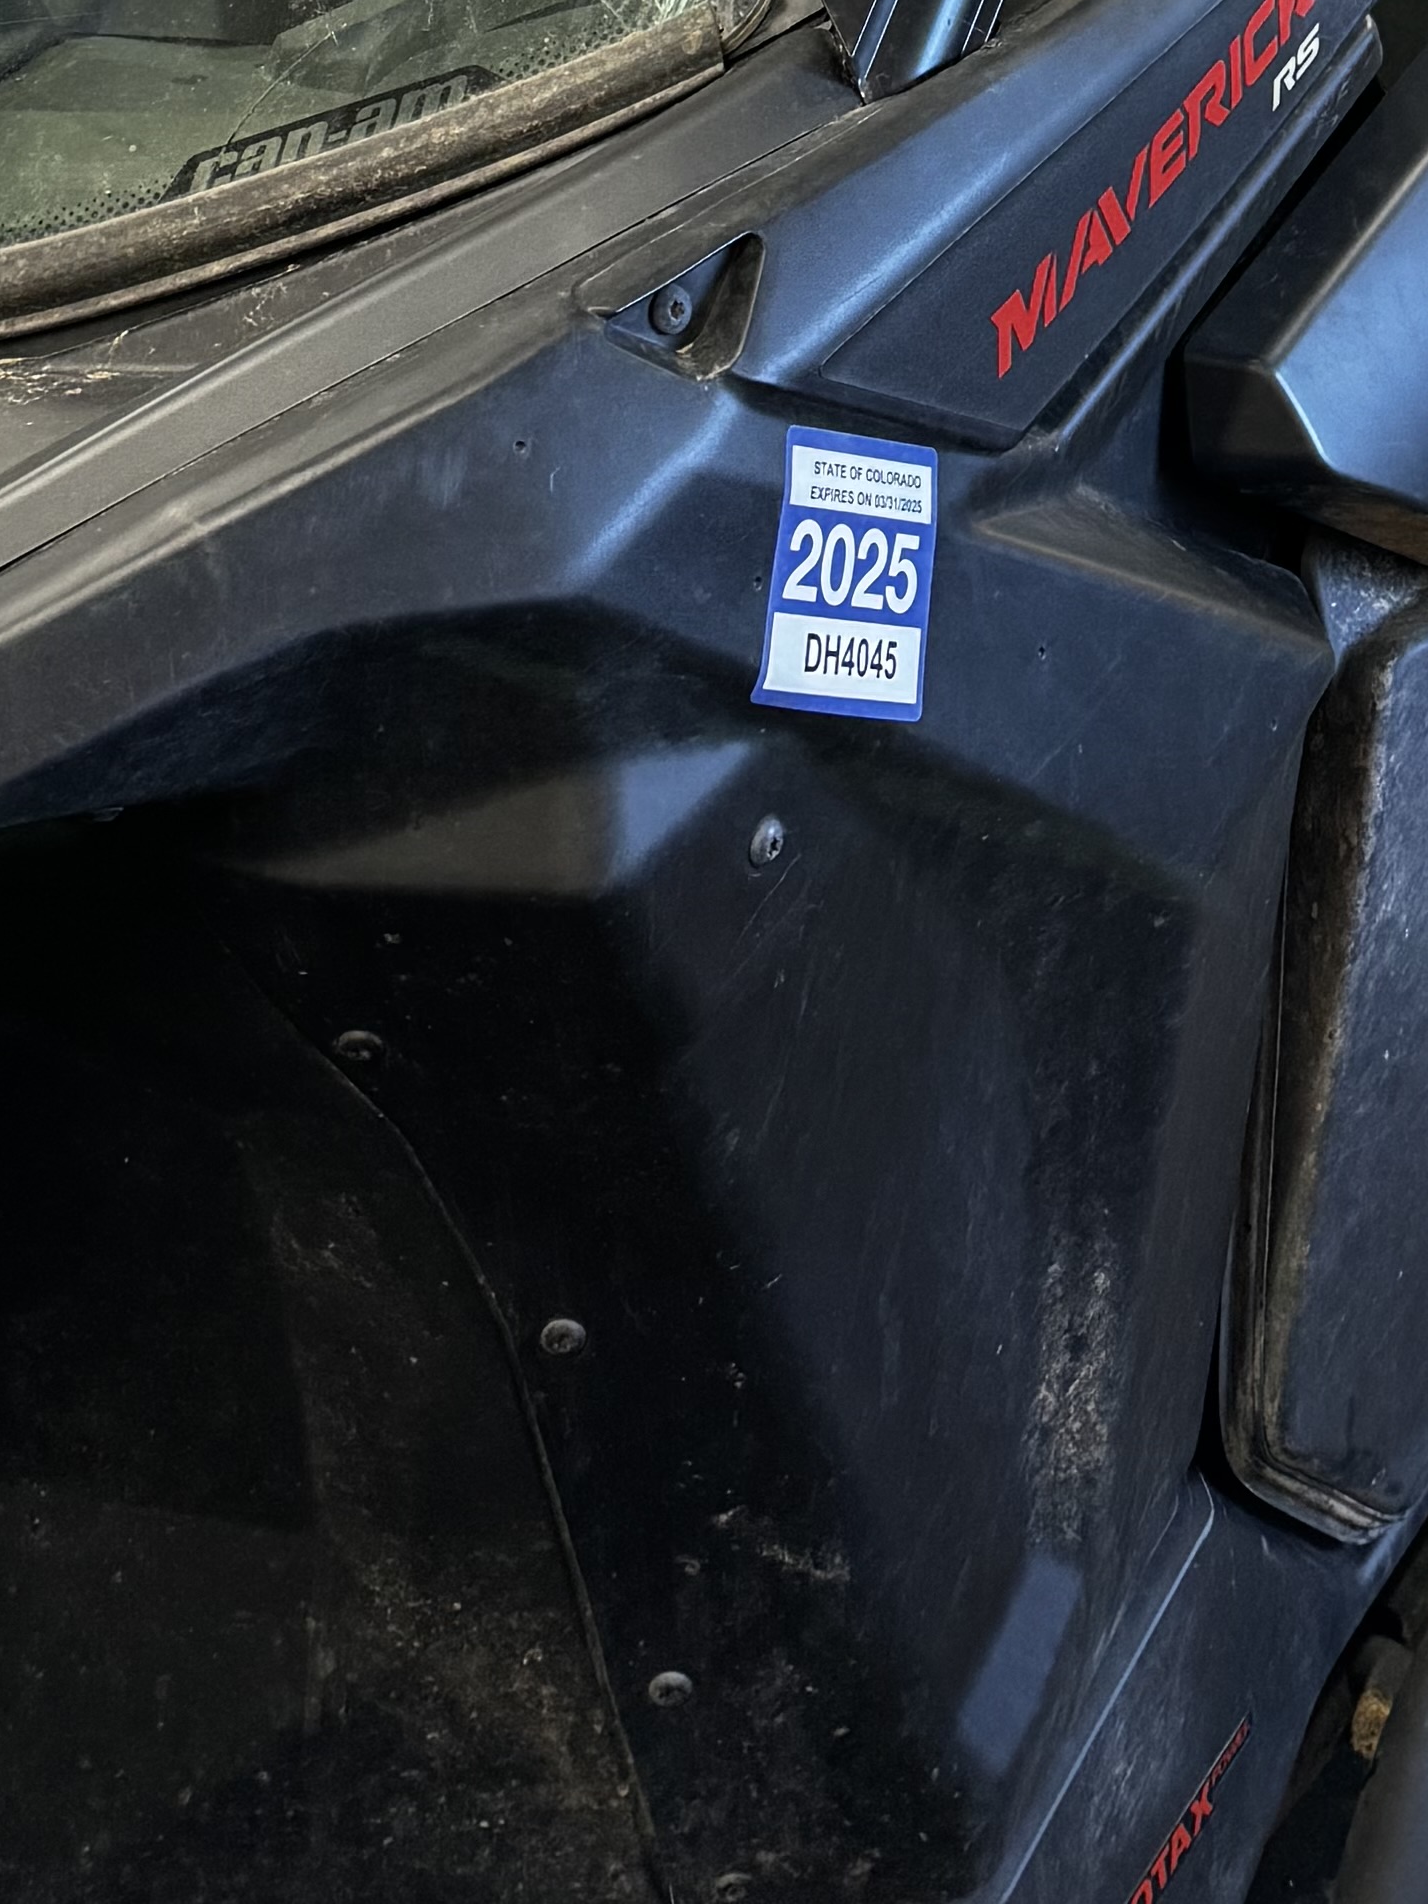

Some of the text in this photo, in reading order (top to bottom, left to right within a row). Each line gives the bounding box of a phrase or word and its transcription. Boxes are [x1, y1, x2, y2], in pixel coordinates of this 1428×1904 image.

[1272, 23, 1320, 112] RS
[810, 486, 854, 504] EXPIRES
[857, 491, 872, 507] ON
[814, 461, 922, 489] STATE OF COLORADO
[782, 518, 920, 615] 2025
[803, 633, 898, 680] DH4045
